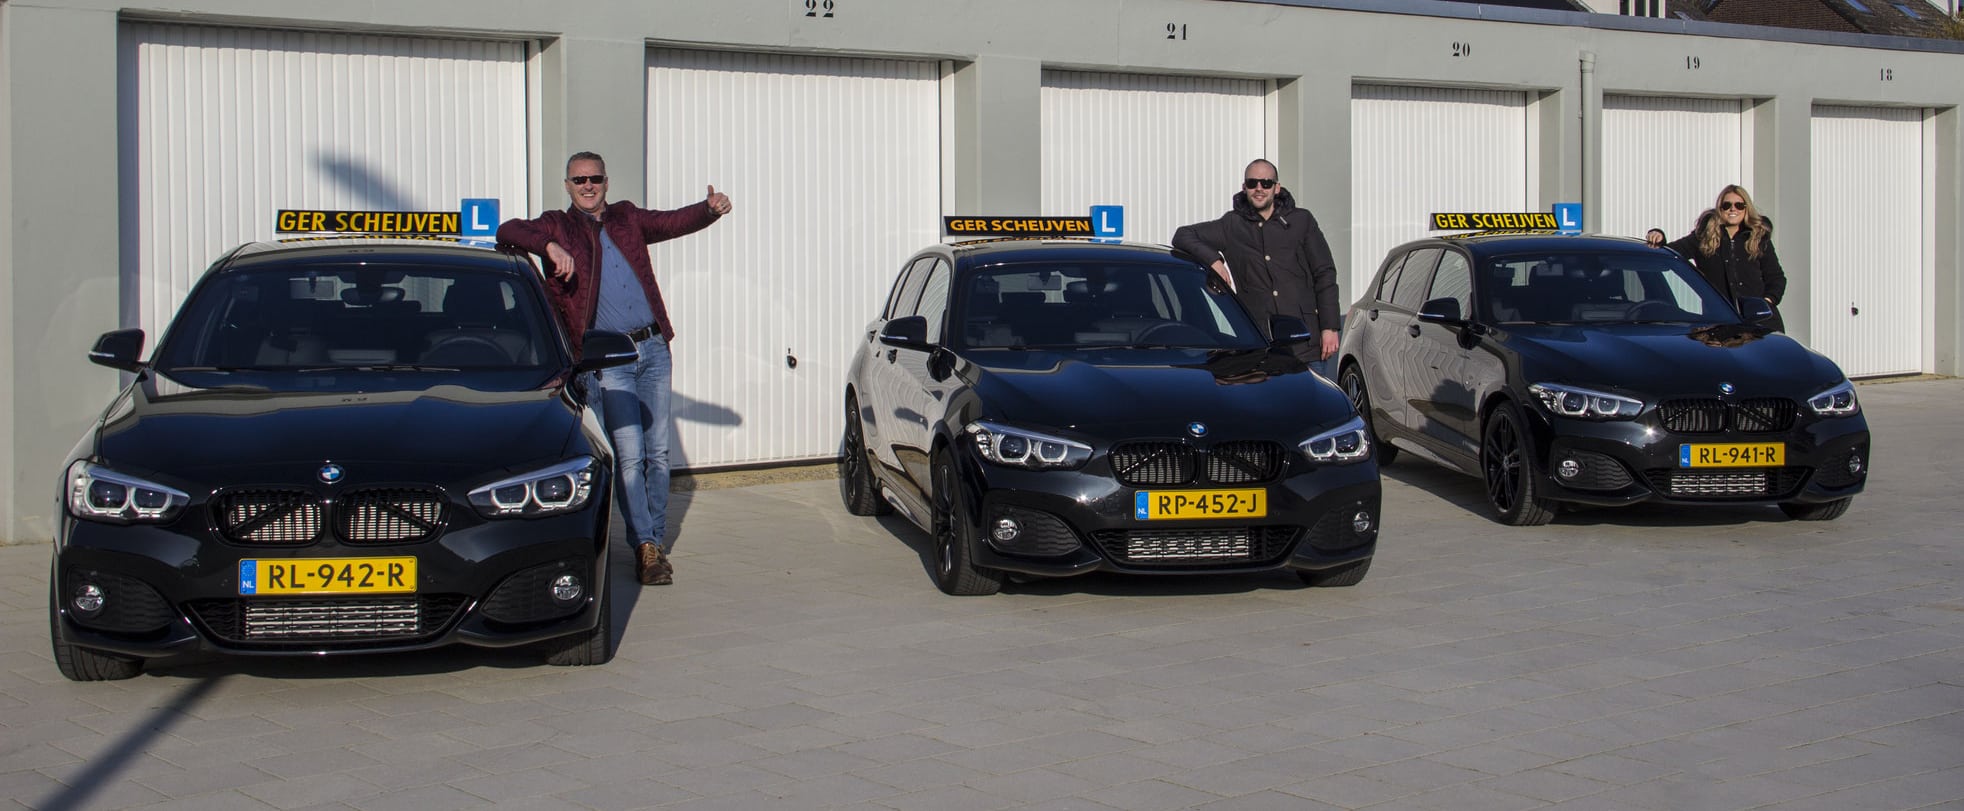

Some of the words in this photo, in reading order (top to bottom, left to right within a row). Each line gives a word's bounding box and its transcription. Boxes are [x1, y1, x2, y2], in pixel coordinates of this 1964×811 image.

[805, 0, 834, 18] 22
[1166, 22, 1187, 40] 21
[1452, 41, 1471, 57] 20
[1687, 55, 1700, 70] 19
[1880, 67, 1893, 81] 18
[279, 211, 326, 231] GER
[335, 212, 457, 233] SCHEIJVEN
[472, 205, 489, 230] L
[950, 219, 988, 232] GER
[991, 219, 1090, 232] SCHEIJVEN
[1101, 211, 1116, 233] L
[1435, 214, 1470, 229] GER
[1471, 214, 1557, 229] SCHEIJVEN
[1562, 207, 1576, 227] L
[1699, 447, 1776, 463] RL-941-R
[1137, 507, 1147, 515] NL
[1158, 493, 1257, 515] RP-452-J
[242, 580, 254, 589] NL
[268, 563, 405, 589] RL-942-R
